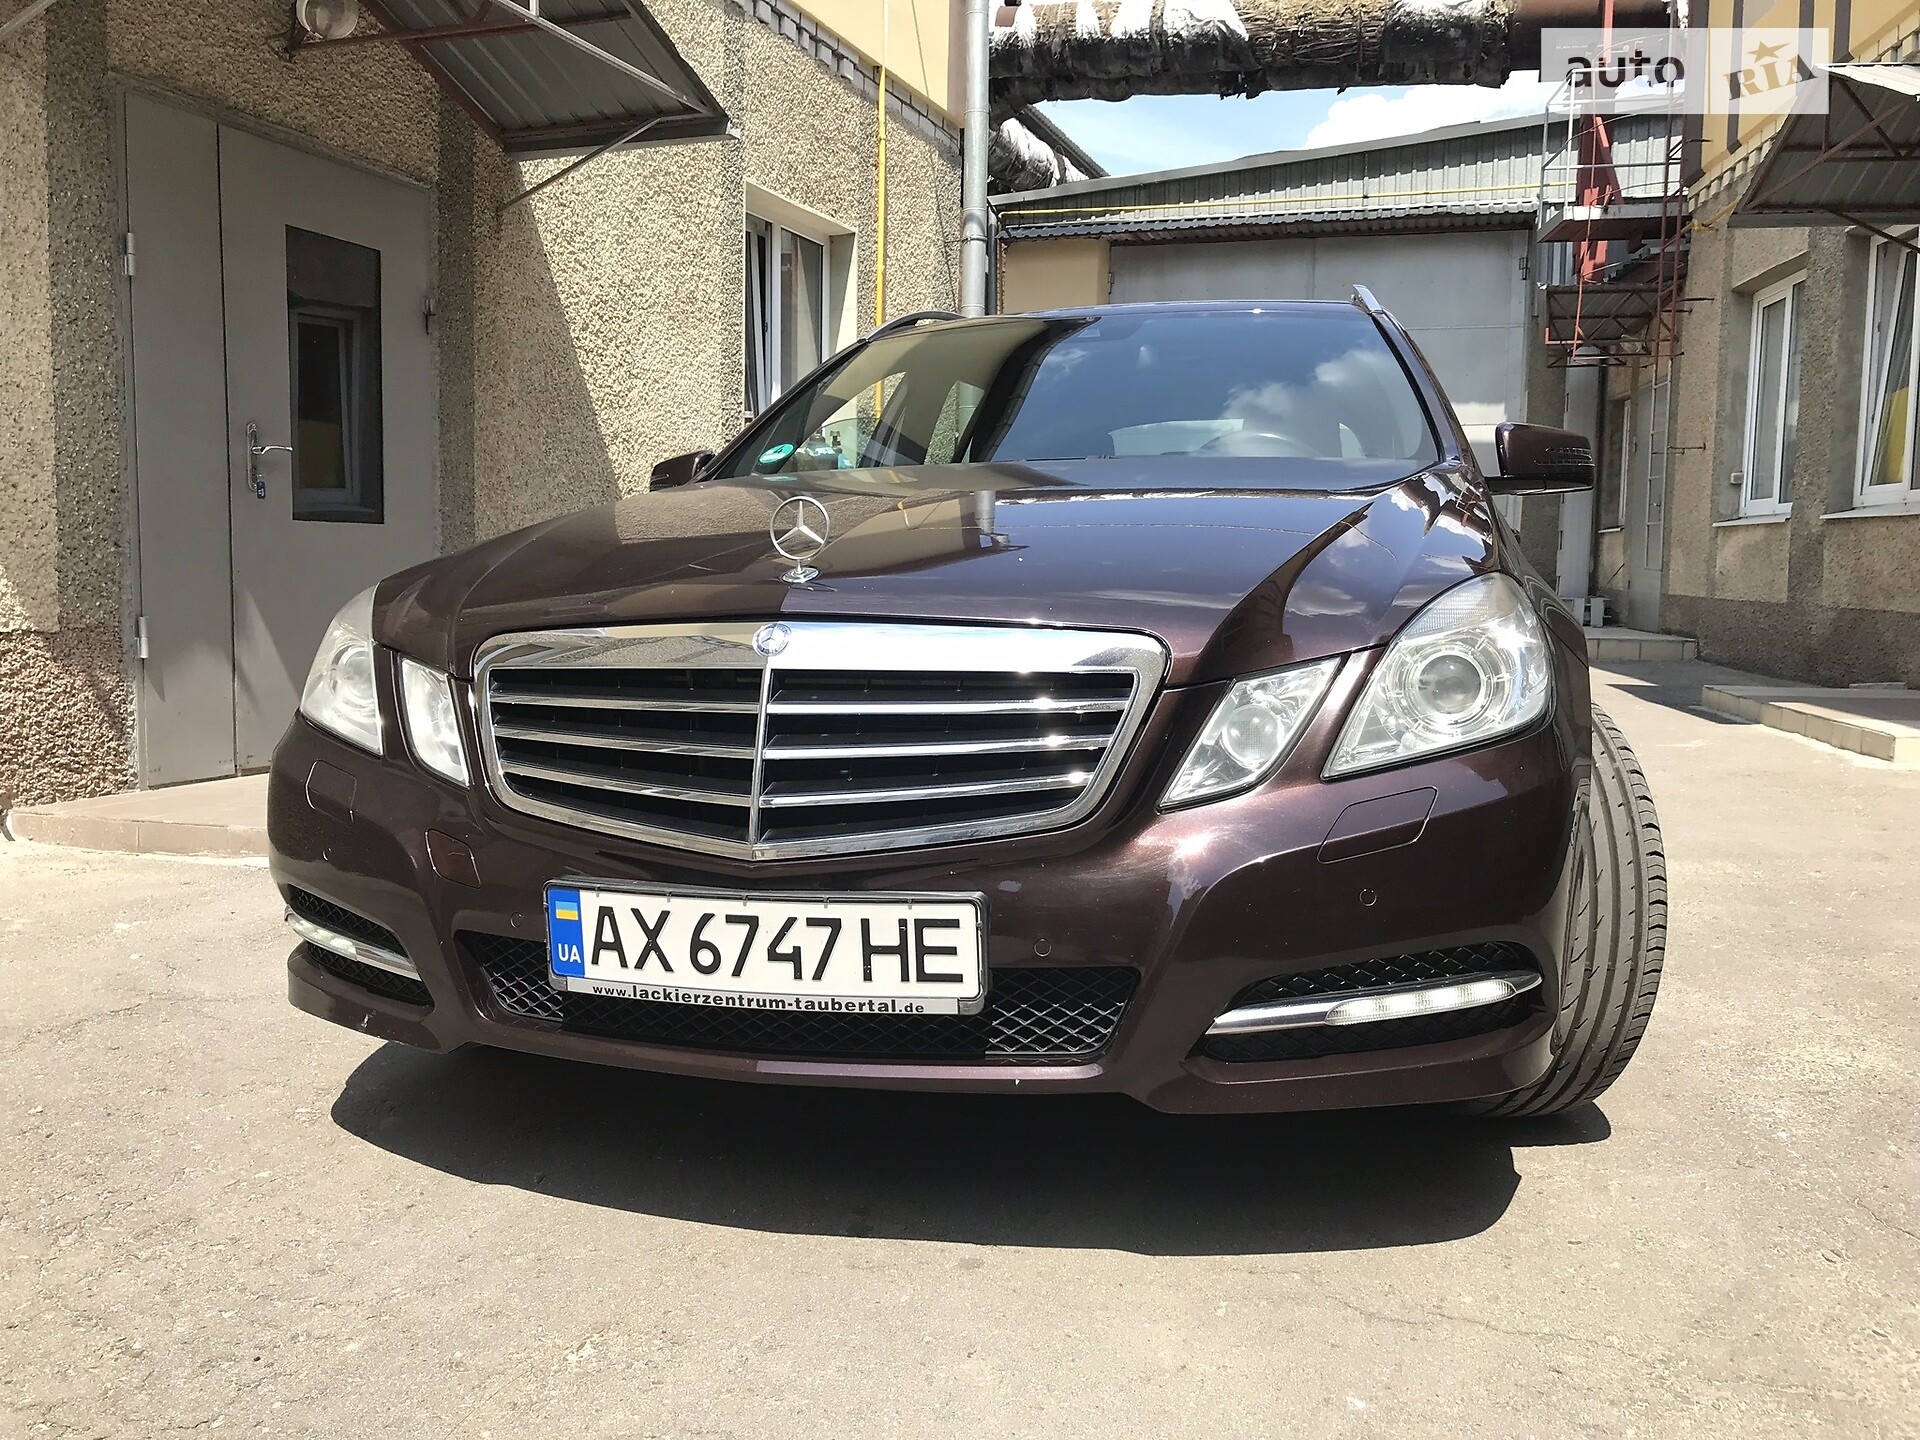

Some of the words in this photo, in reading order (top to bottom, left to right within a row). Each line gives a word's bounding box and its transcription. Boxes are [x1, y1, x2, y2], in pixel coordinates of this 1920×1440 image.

[557, 943, 582, 964] UA
[591, 905, 674, 973] AX
[689, 912, 842, 981] 6747
[860, 918, 963, 983] HE
[592, 985, 925, 1013] www.lackierzentrum-taubertal.de
